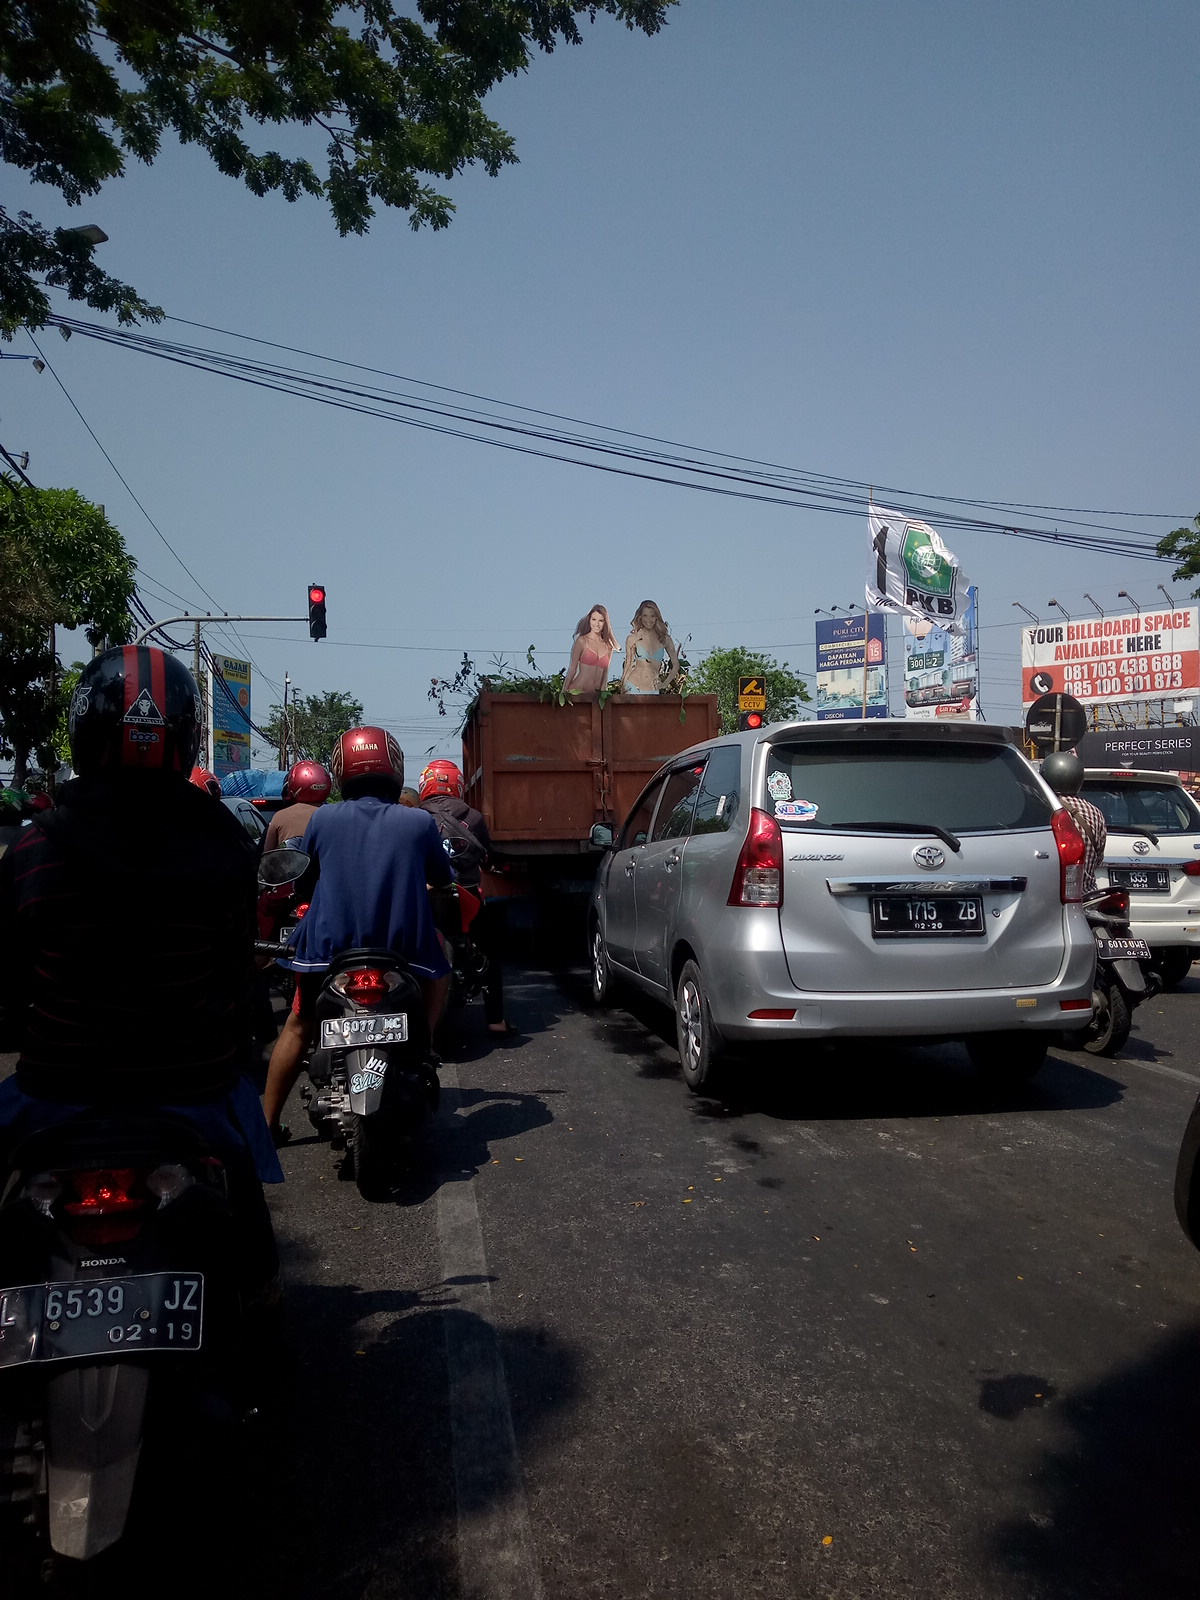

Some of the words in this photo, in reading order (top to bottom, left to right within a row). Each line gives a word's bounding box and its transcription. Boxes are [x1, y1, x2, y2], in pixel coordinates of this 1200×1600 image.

[906, 588, 954, 615] PKB
[850, 626, 865, 634] CITY
[1029, 626, 1063, 645] YOUR
[1067, 617, 1141, 641] BILLBOARD
[1144, 611, 1191, 632] SPACE
[870, 648, 880, 657] 15
[1054, 638, 1124, 661] AVAILABLE
[1126, 634, 1162, 653] HERE
[827, 652, 857, 661] DAPATKAN
[932, 657, 938, 667] 2
[224, 659, 248, 673] GAJAH
[910, 659, 924, 669] 300
[1063, 664, 1089, 682] 081
[1091, 660, 1117, 679] 703
[1119, 657, 1149, 675] 438
[1151, 653, 1183, 673] 688
[1063, 680, 1092, 697] 085
[1095, 677, 1121, 695] 100
[1124, 675, 1151, 692] 301
[1154, 671, 1183, 690] 873
[351, 743, 379, 753] YAMAHA
[1105, 740, 1153, 752] PERFECT
[1154, 738, 1192, 750] SERIES
[778, 806, 801, 815] WBL
[788, 853, 845, 862] AVANZA
[1113, 872, 1118, 882] L
[1130, 872, 1147, 883] 1355
[879, 902, 889, 920] L
[907, 901, 937, 920] 1715
[958, 901, 977, 920] ZB
[1108, 941, 1128, 949] 6013
[325, 1023, 334, 1035] L
[342, 1019, 376, 1034] 6077
[80, 1257, 127, 1268] HONDA
[46, 1285, 124, 1321] 6539
[164, 1280, 199, 1311] JZ
